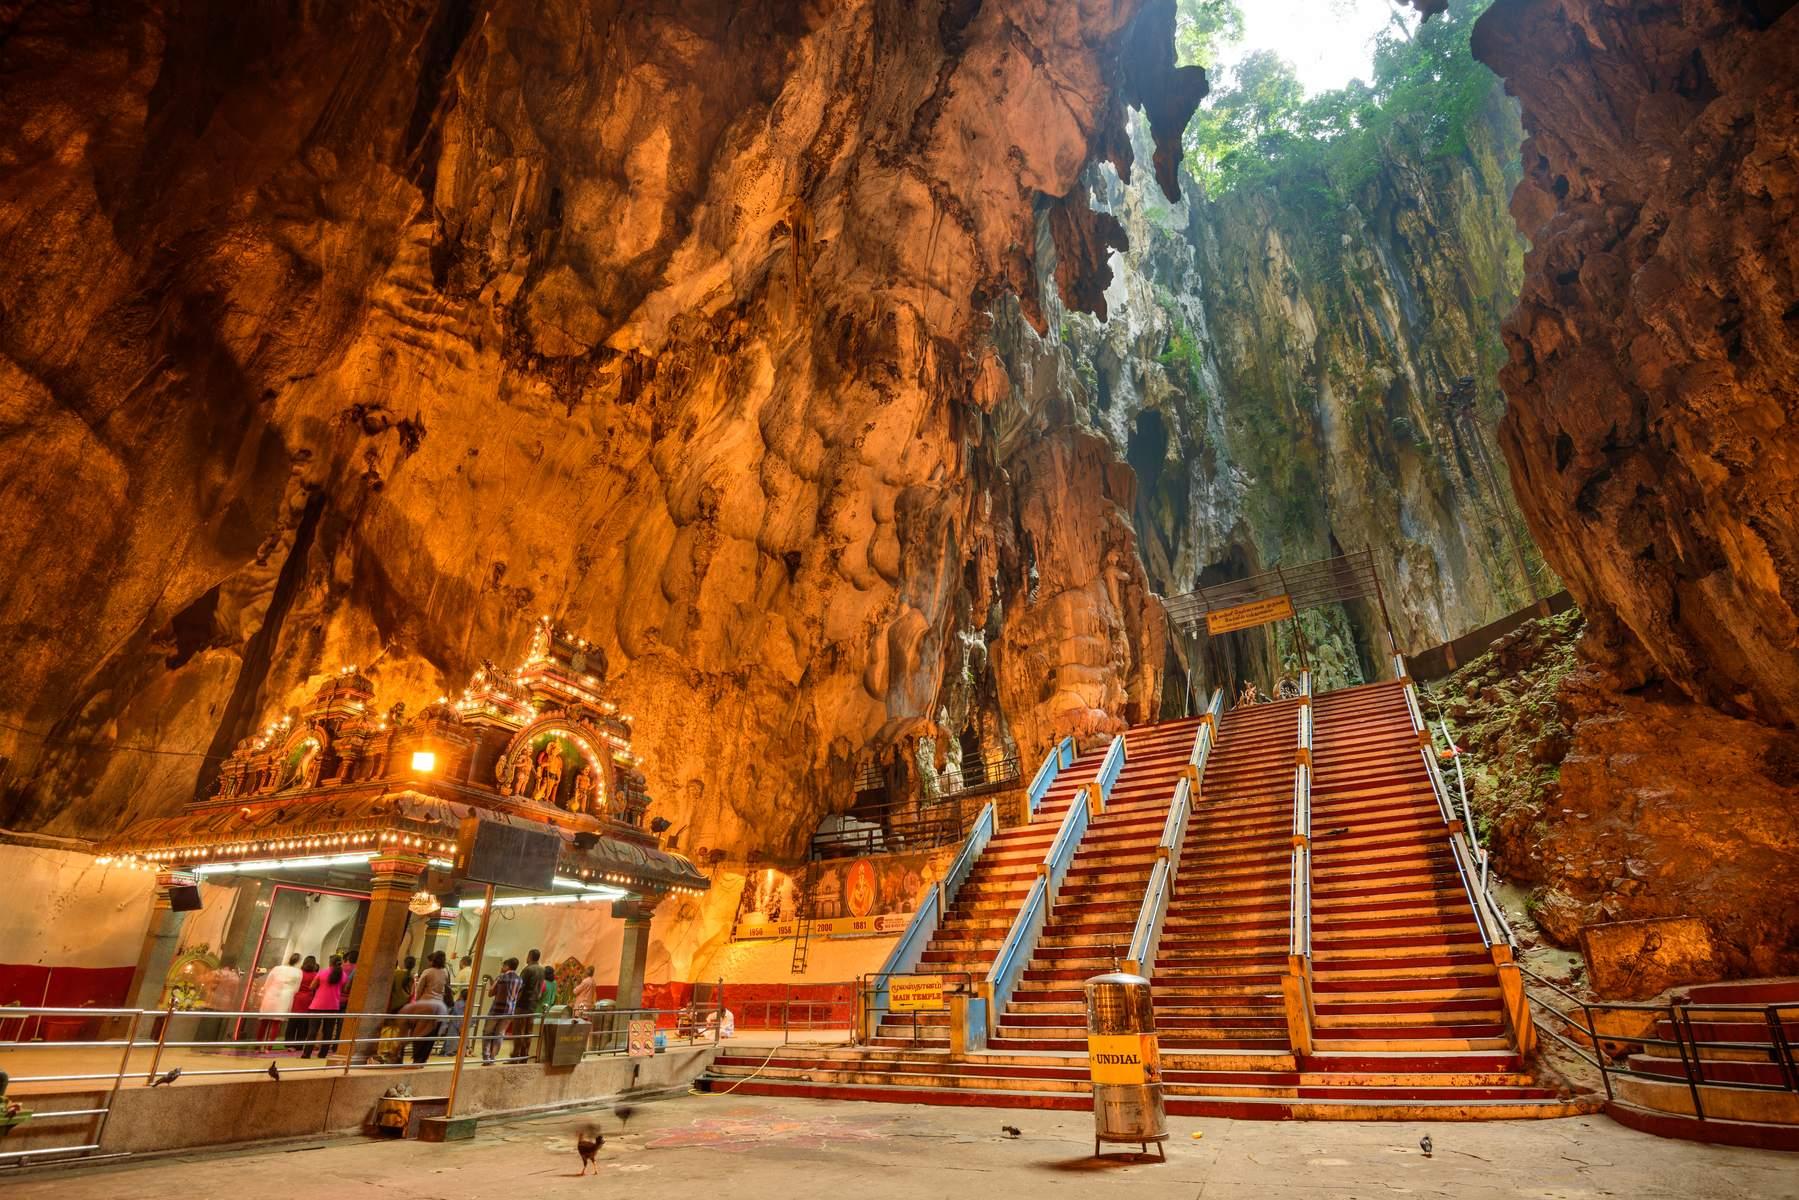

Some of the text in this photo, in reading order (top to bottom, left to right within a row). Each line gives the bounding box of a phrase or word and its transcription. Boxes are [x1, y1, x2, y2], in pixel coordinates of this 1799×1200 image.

[817, 923, 833, 932] 2000
[853, 921, 867, 930] 1881
[912, 993, 942, 1001] TEMPLE
[1096, 1054, 1141, 1064] UNDIAL
